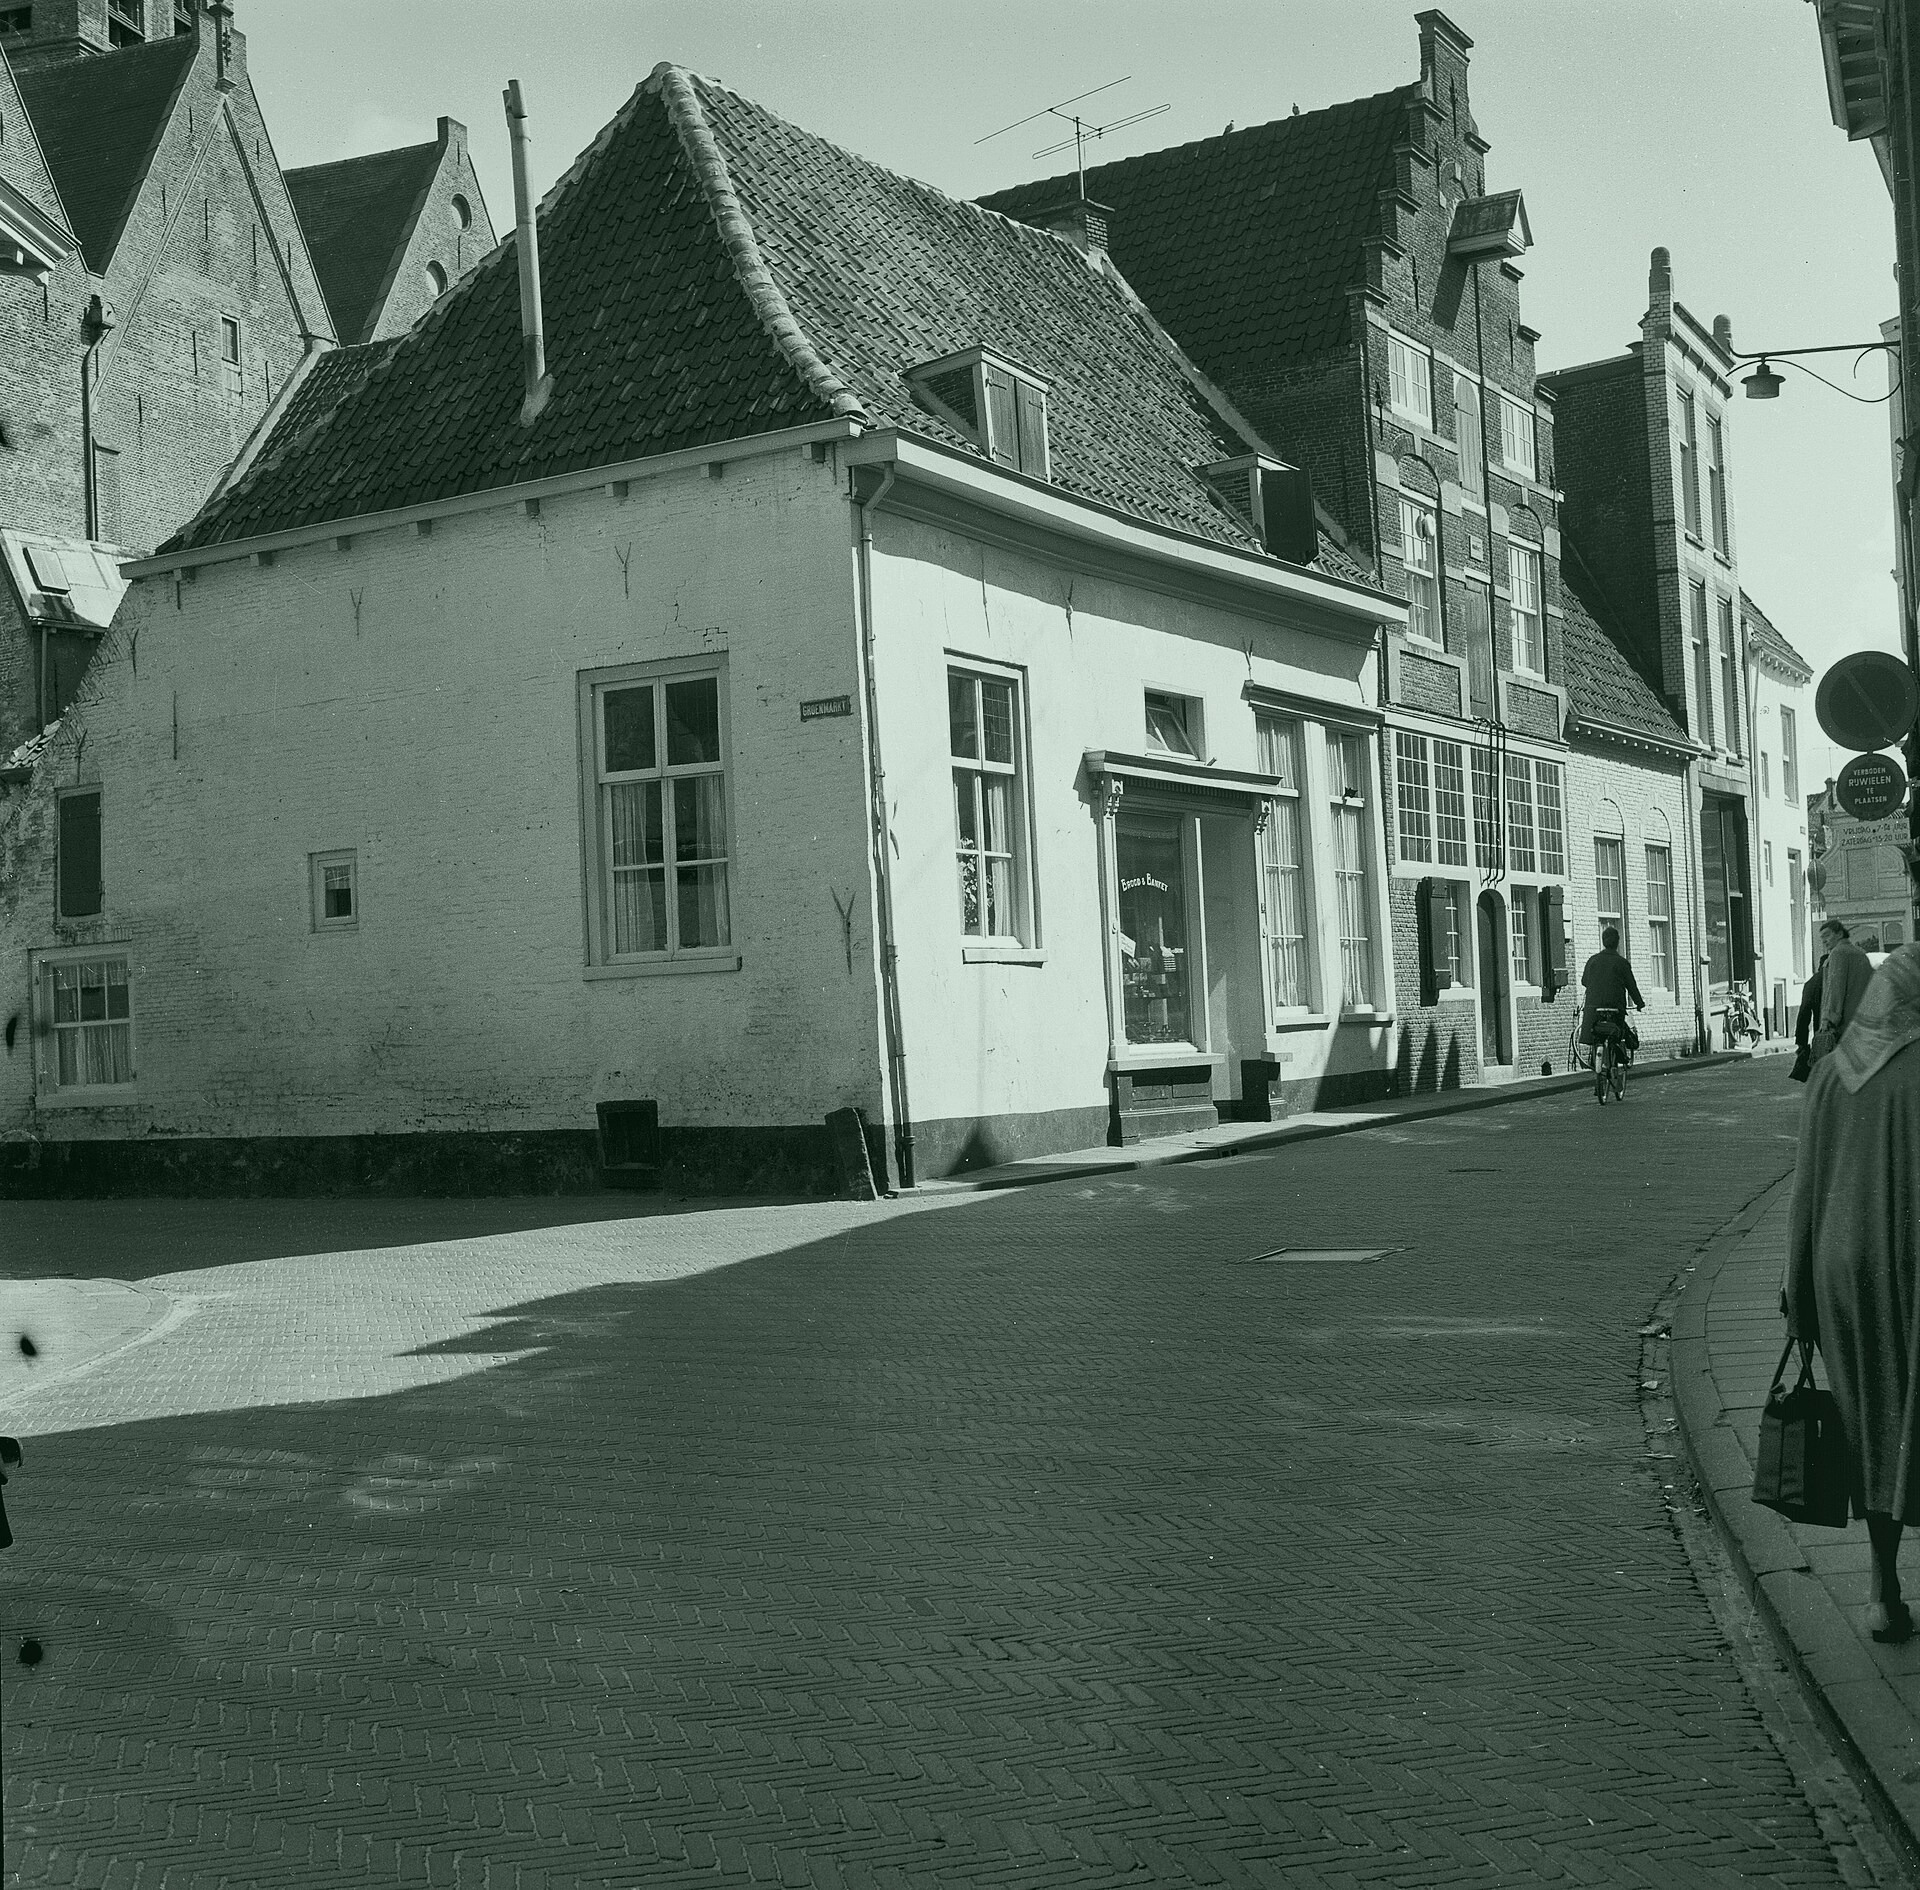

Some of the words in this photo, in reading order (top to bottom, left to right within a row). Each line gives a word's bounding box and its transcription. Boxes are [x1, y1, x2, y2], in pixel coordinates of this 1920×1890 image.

[802, 700, 847, 717] GROENMARKT
[1853, 767, 1886, 776] VERBODEN
[1866, 787, 1875, 795] TE
[1854, 795, 1888, 805] PLAATSEN
